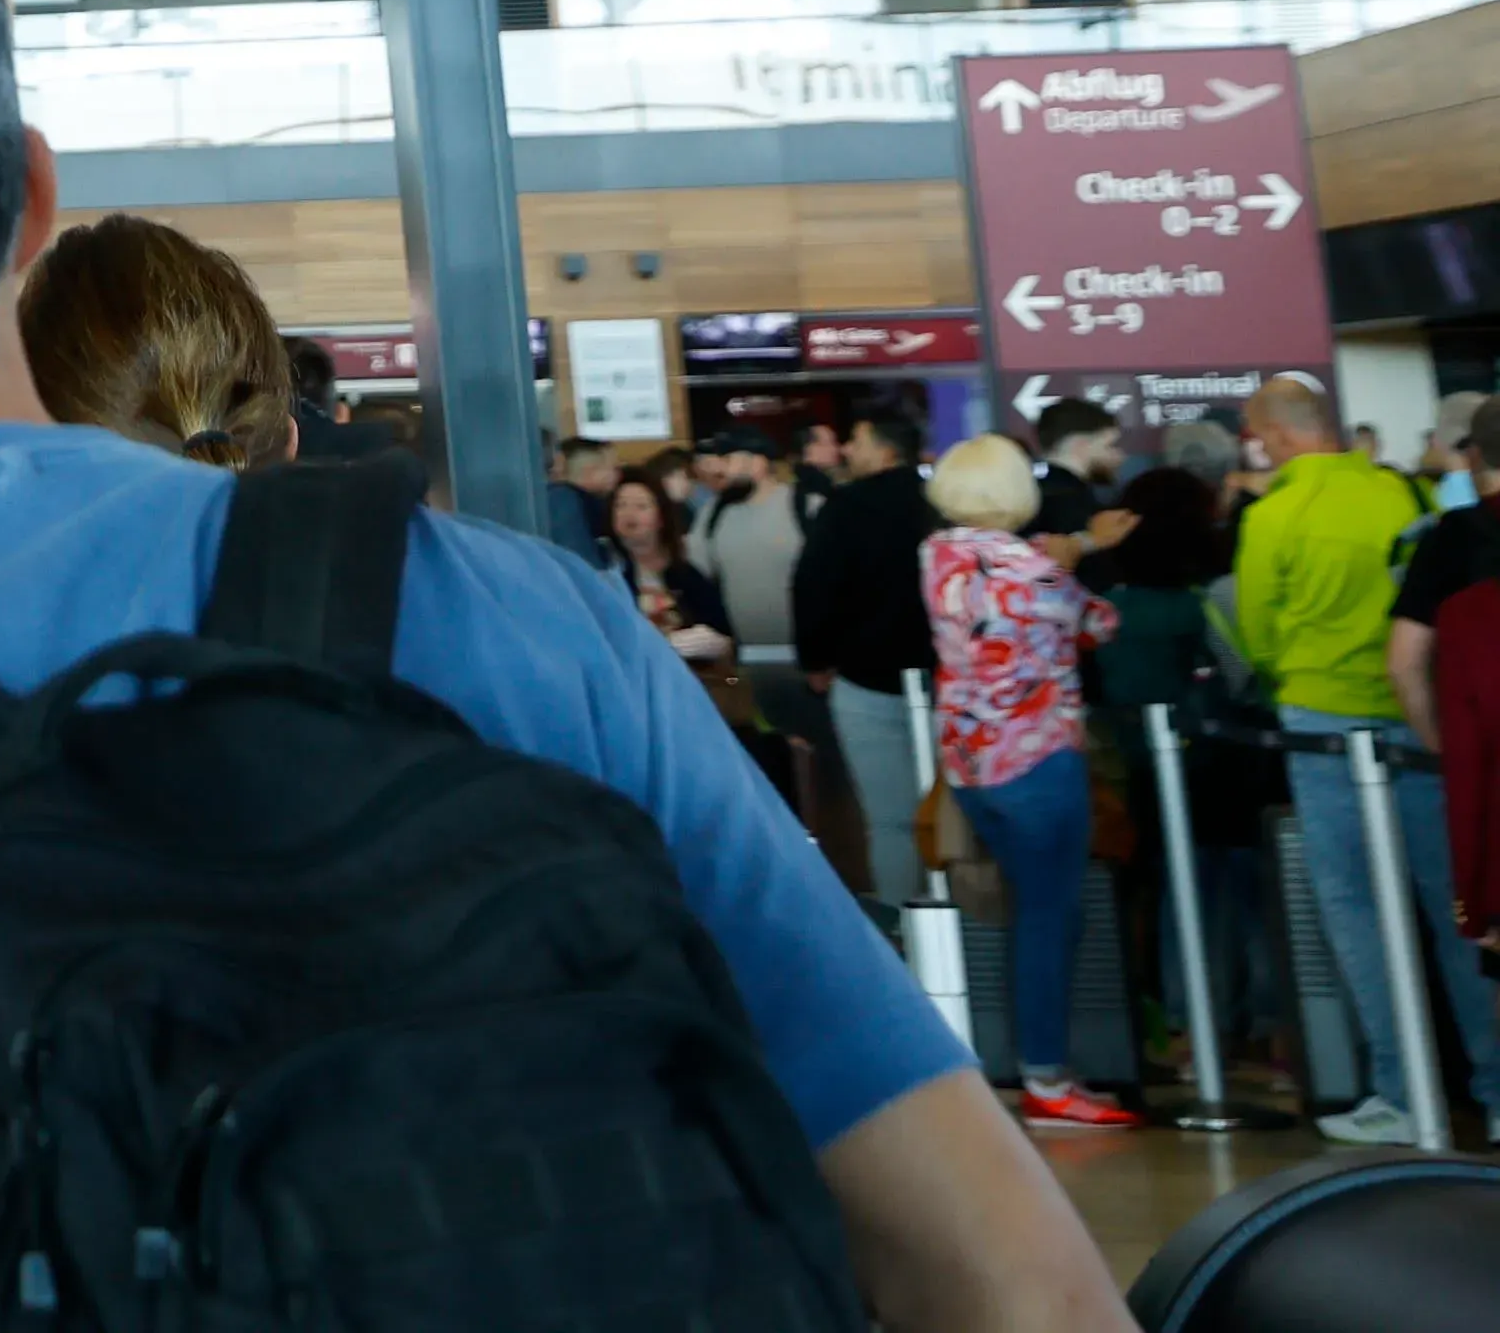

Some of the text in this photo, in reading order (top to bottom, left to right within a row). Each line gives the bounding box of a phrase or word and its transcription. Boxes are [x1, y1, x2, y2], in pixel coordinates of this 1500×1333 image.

[1036, 67, 1165, 108] Abflug
[1043, 108, 1185, 135] Departure
[1075, 167, 1236, 204] Check-in
[1063, 263, 1225, 300] Check-in
[1136, 372, 1260, 398] Terminal
